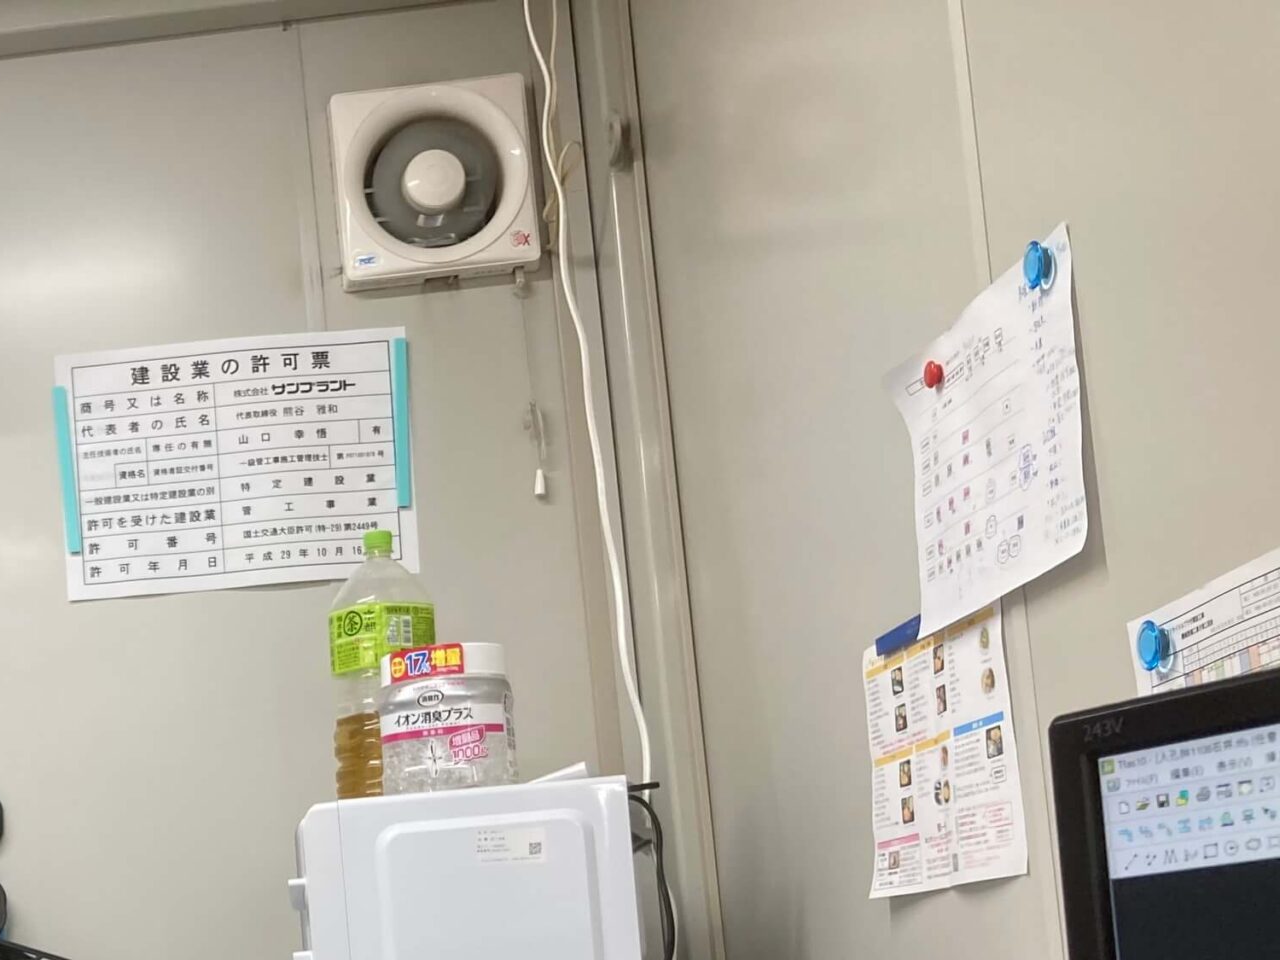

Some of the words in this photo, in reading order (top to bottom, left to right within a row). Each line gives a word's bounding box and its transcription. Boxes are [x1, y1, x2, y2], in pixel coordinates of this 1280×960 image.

[131, 351, 331, 386] 建設業の許可票
[80, 390, 209, 414] 商号又は名称
[233, 385, 268, 398] 株式会社
[82, 415, 210, 438] 代表者の氏名
[372, 425, 381, 435] 有
[119, 470, 146, 481] 資格名
[241, 474, 376, 492] 特定建設業
[85, 486, 215, 506] 一般建設業又は特定建設業の別
[87, 509, 216, 532] 許可を受けた建設業
[88, 532, 217, 555] 許可番号
[90, 557, 217, 578] 許可年月日
[394, 706, 474, 728] イオン消臭プラス
